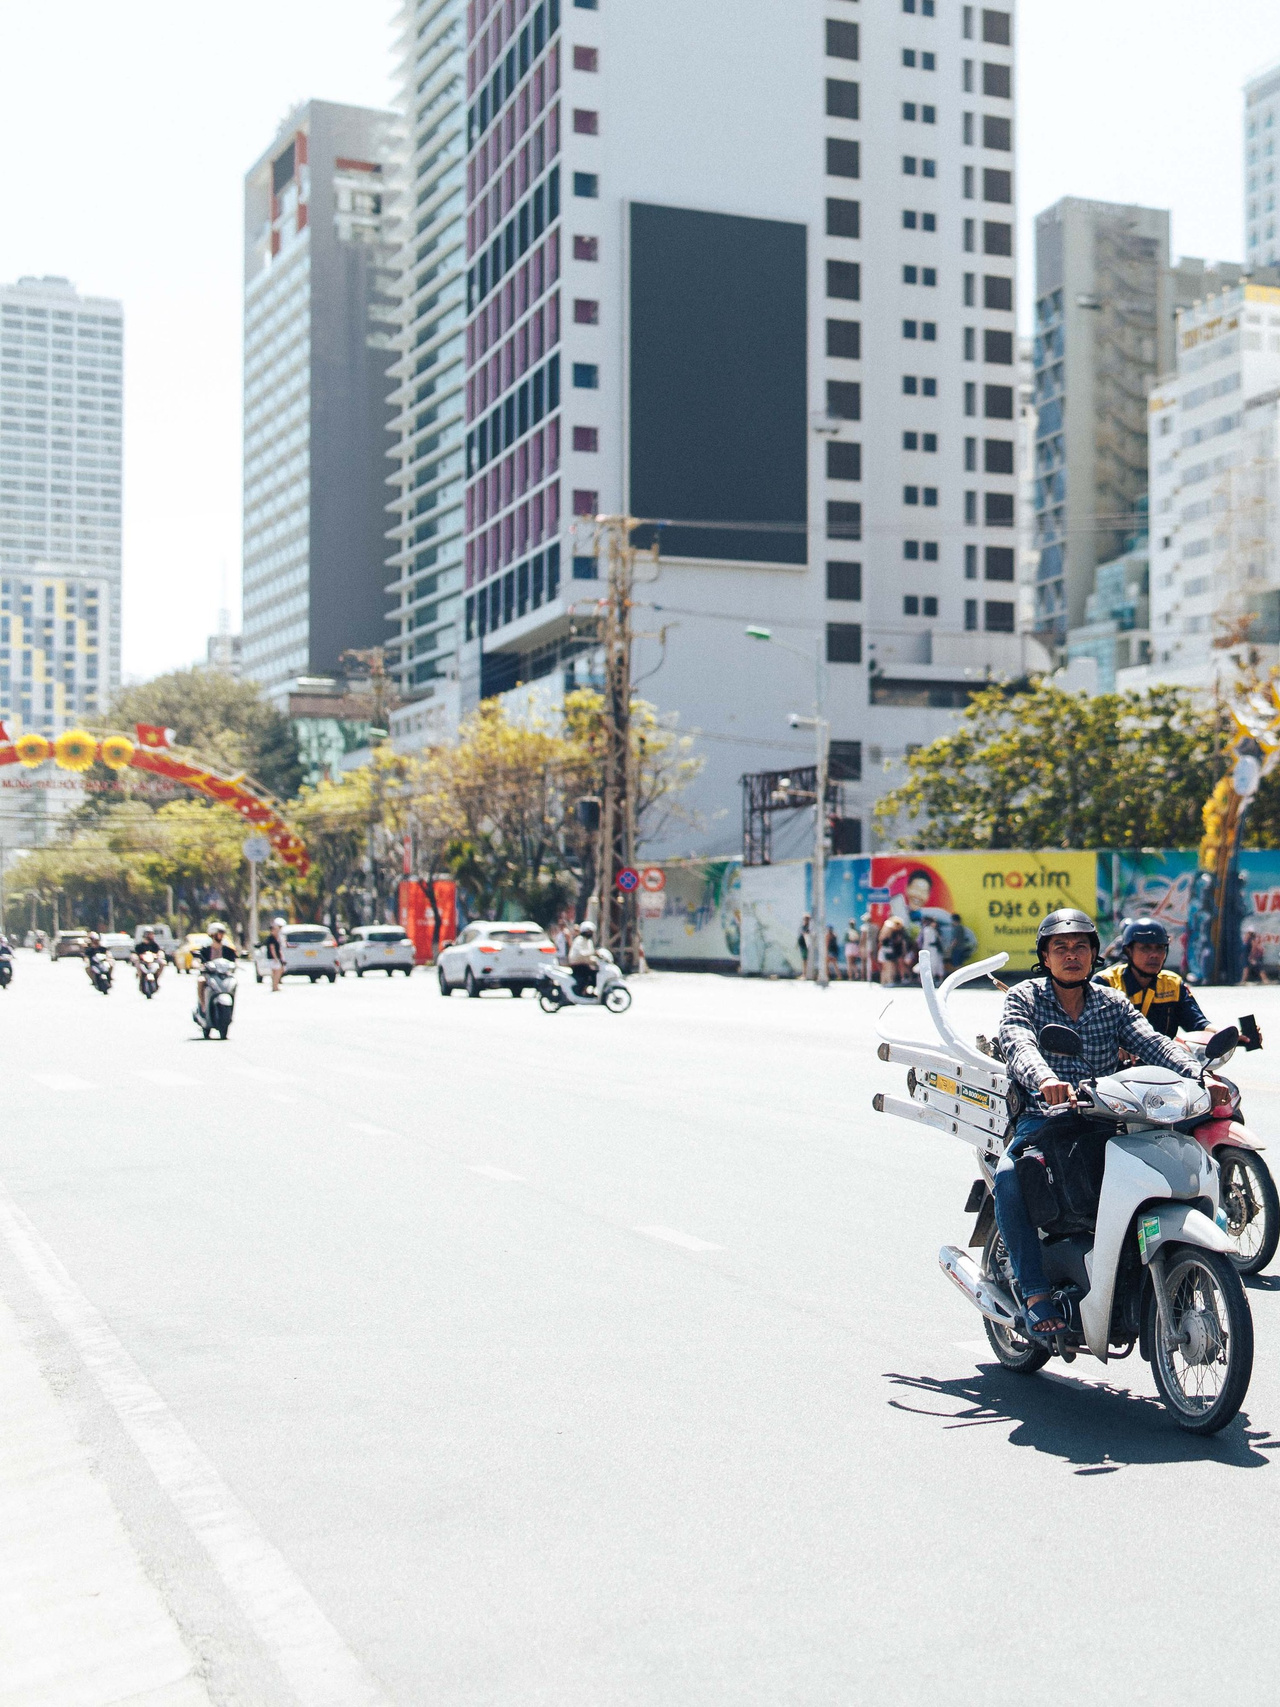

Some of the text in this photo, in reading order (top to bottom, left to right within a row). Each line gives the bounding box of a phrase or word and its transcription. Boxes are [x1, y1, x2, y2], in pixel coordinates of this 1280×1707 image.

[982, 866, 1070, 889] maxim
[988, 900, 1022, 919] Đặt
[1028, 901, 1040, 917] ô
